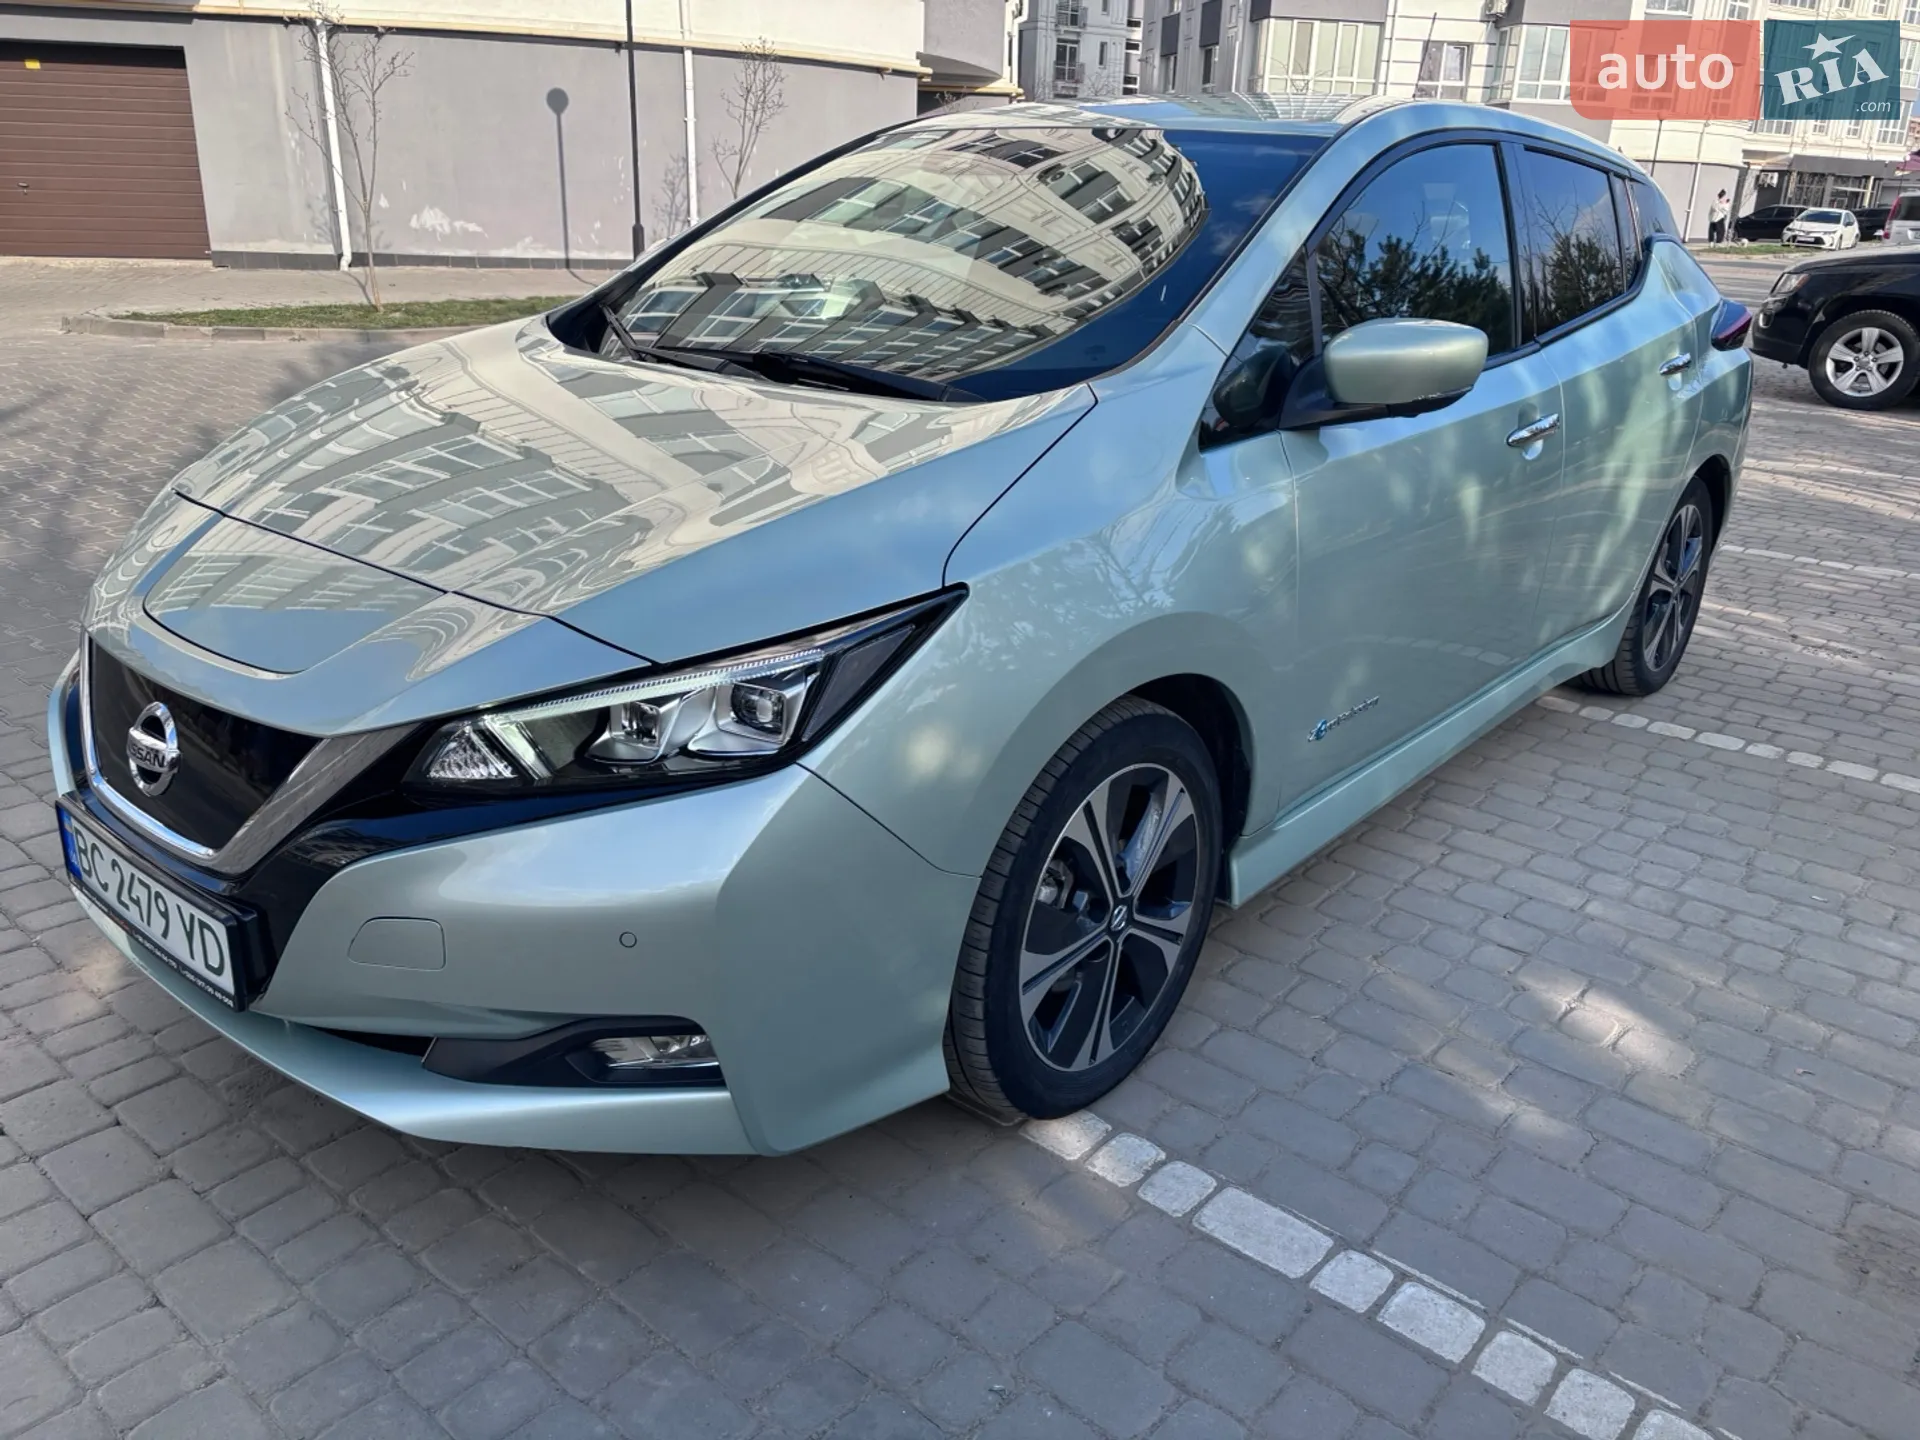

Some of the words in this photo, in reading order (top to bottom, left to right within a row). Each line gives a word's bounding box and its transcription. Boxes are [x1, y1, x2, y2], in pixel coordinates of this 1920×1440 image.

[74, 826, 109, 892] BC
[111, 857, 170, 940] 2479
[176, 902, 225, 977] YD
